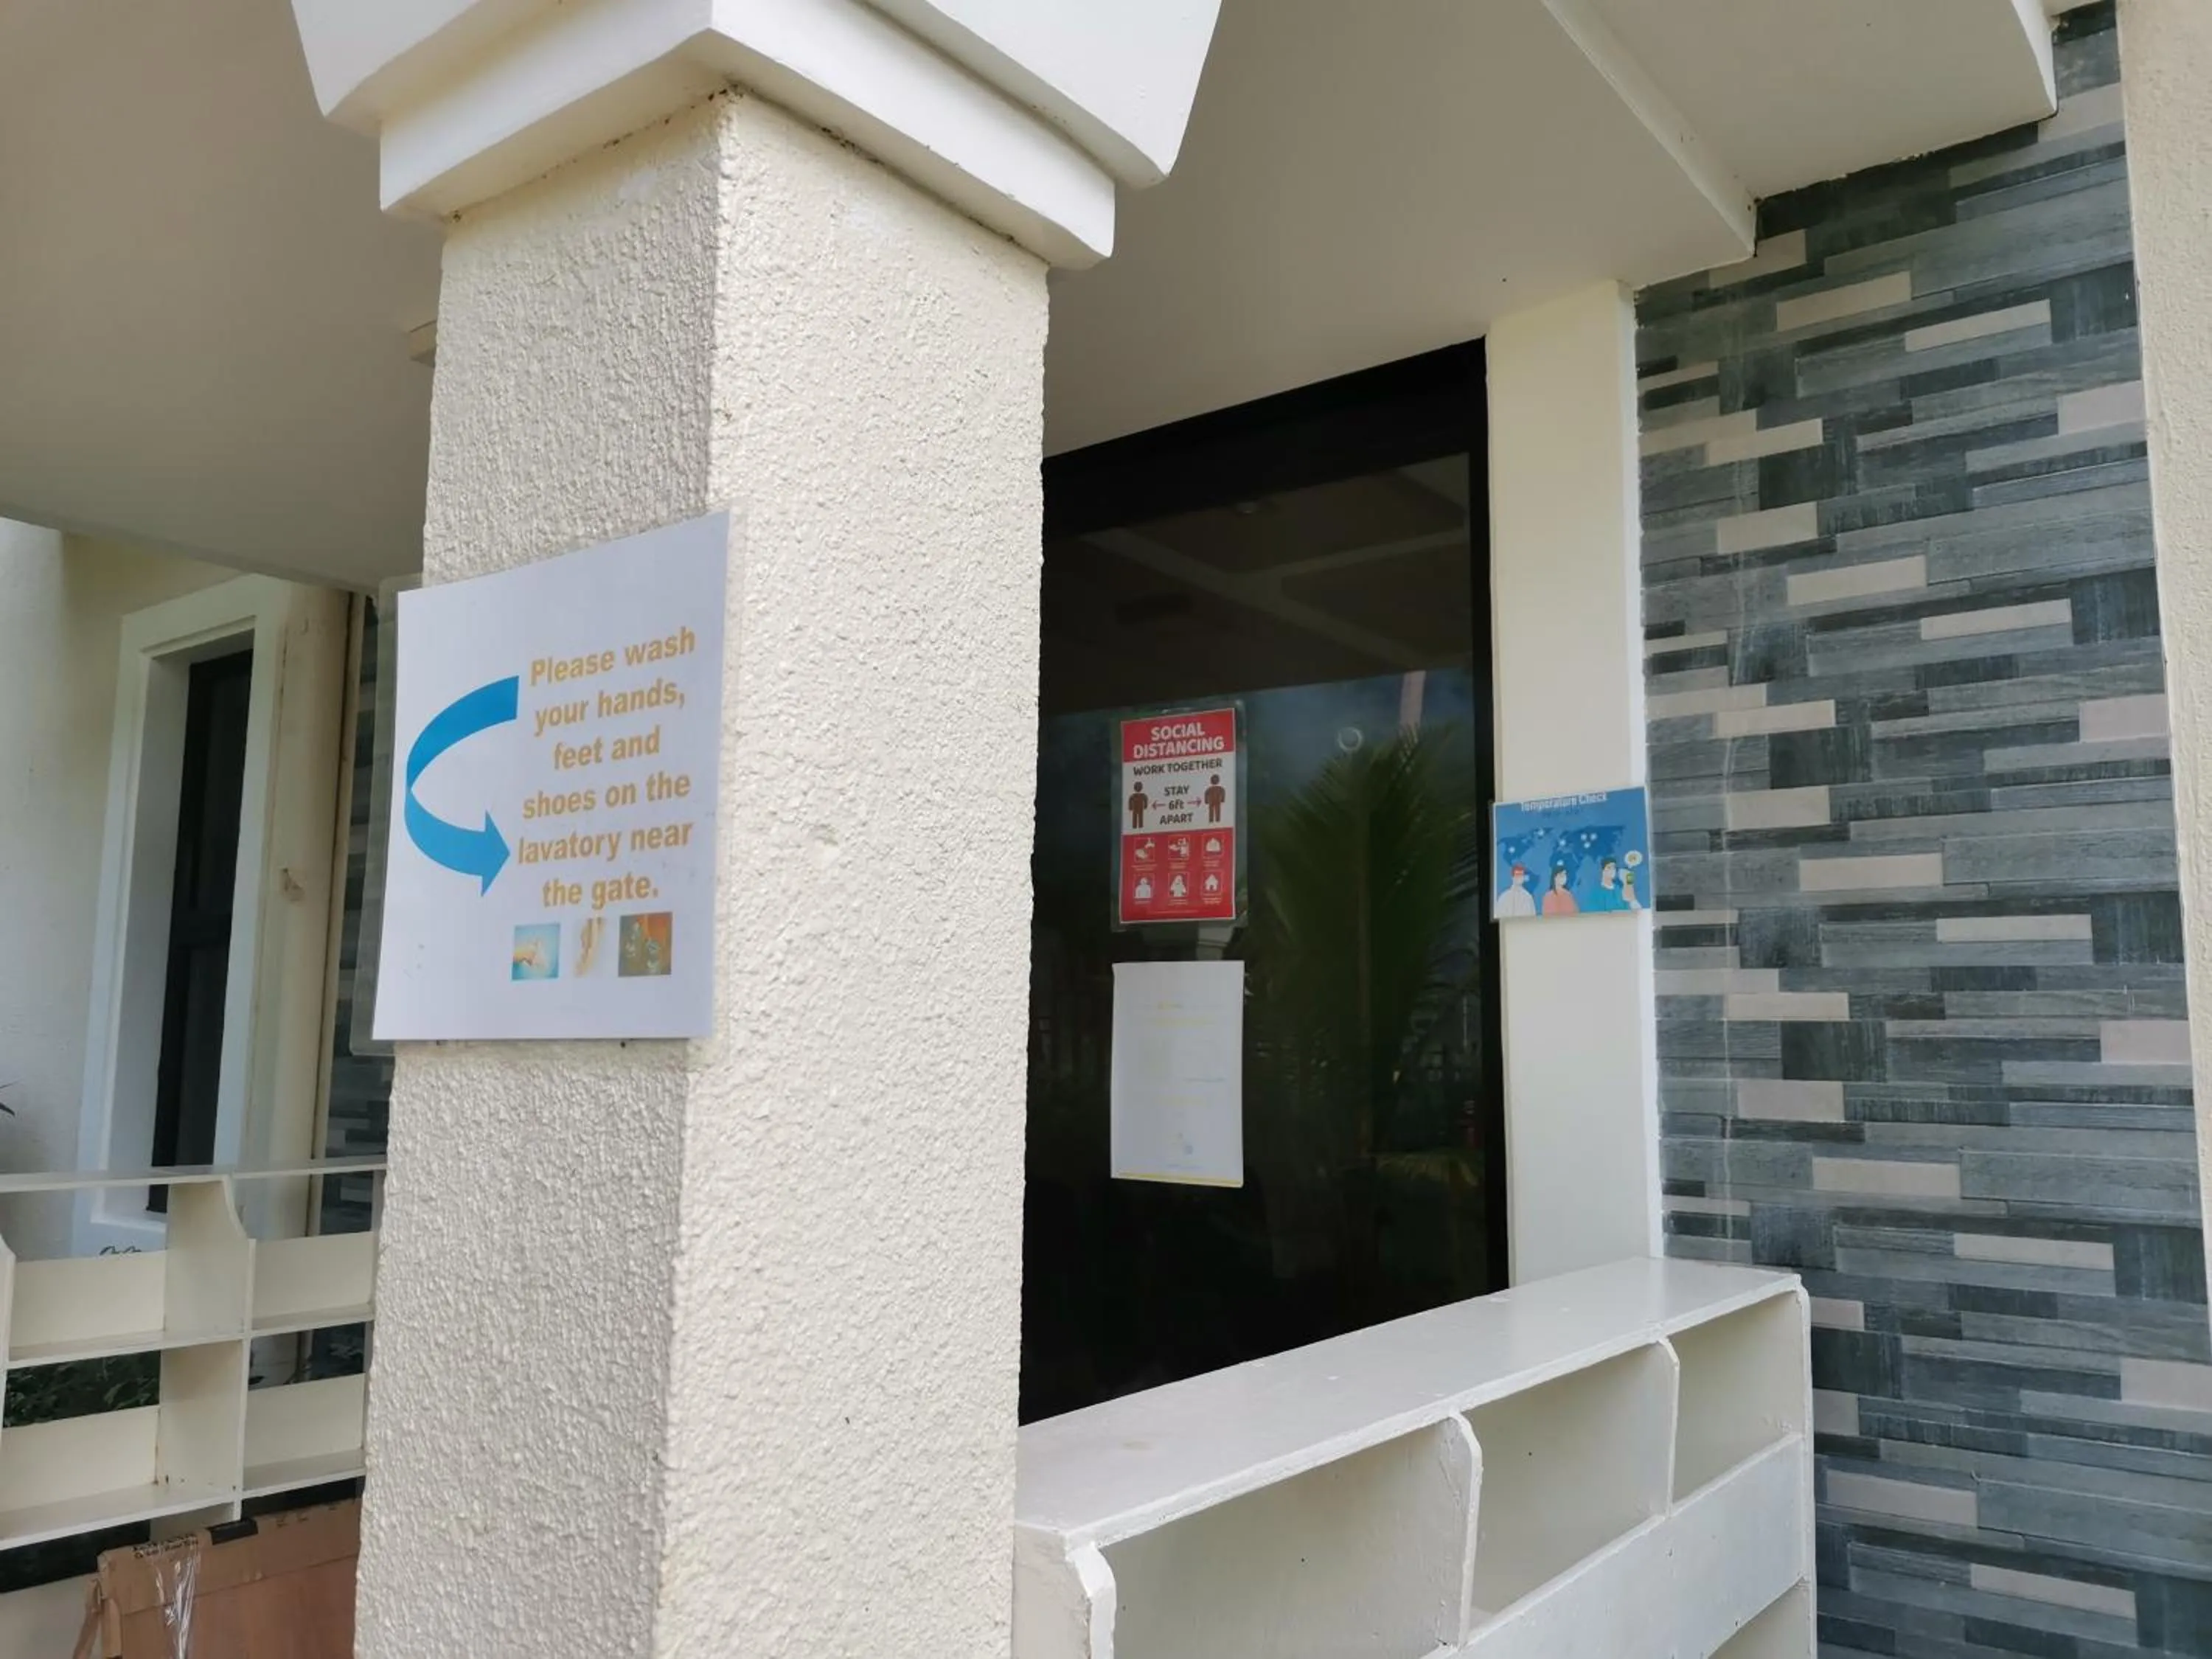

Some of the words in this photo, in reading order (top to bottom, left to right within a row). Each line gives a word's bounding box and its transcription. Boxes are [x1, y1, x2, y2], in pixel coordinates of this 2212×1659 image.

[529, 650, 615, 687] Please
[624, 626, 696, 667] wash
[534, 697, 590, 737] your
[597, 678, 686, 719] hands,
[1151, 723, 1206, 741] SOCIAL
[553, 738, 603, 770] feet
[611, 726, 661, 762] and
[1133, 736, 1225, 759] DISTANCING
[1133, 763, 1165, 776] WORK
[1167, 758, 1222, 772] TOGETHER
[522, 789, 597, 820] shoes
[605, 785, 637, 807] on
[646, 771, 692, 801] the
[1164, 785, 1189, 796] STAY
[1169, 799, 1184, 810] 6ft
[1160, 813, 1194, 825] APART
[518, 830, 622, 865] lavatory
[630, 821, 693, 851] near
[542, 877, 582, 908] the
[591, 873, 659, 911] gate.
